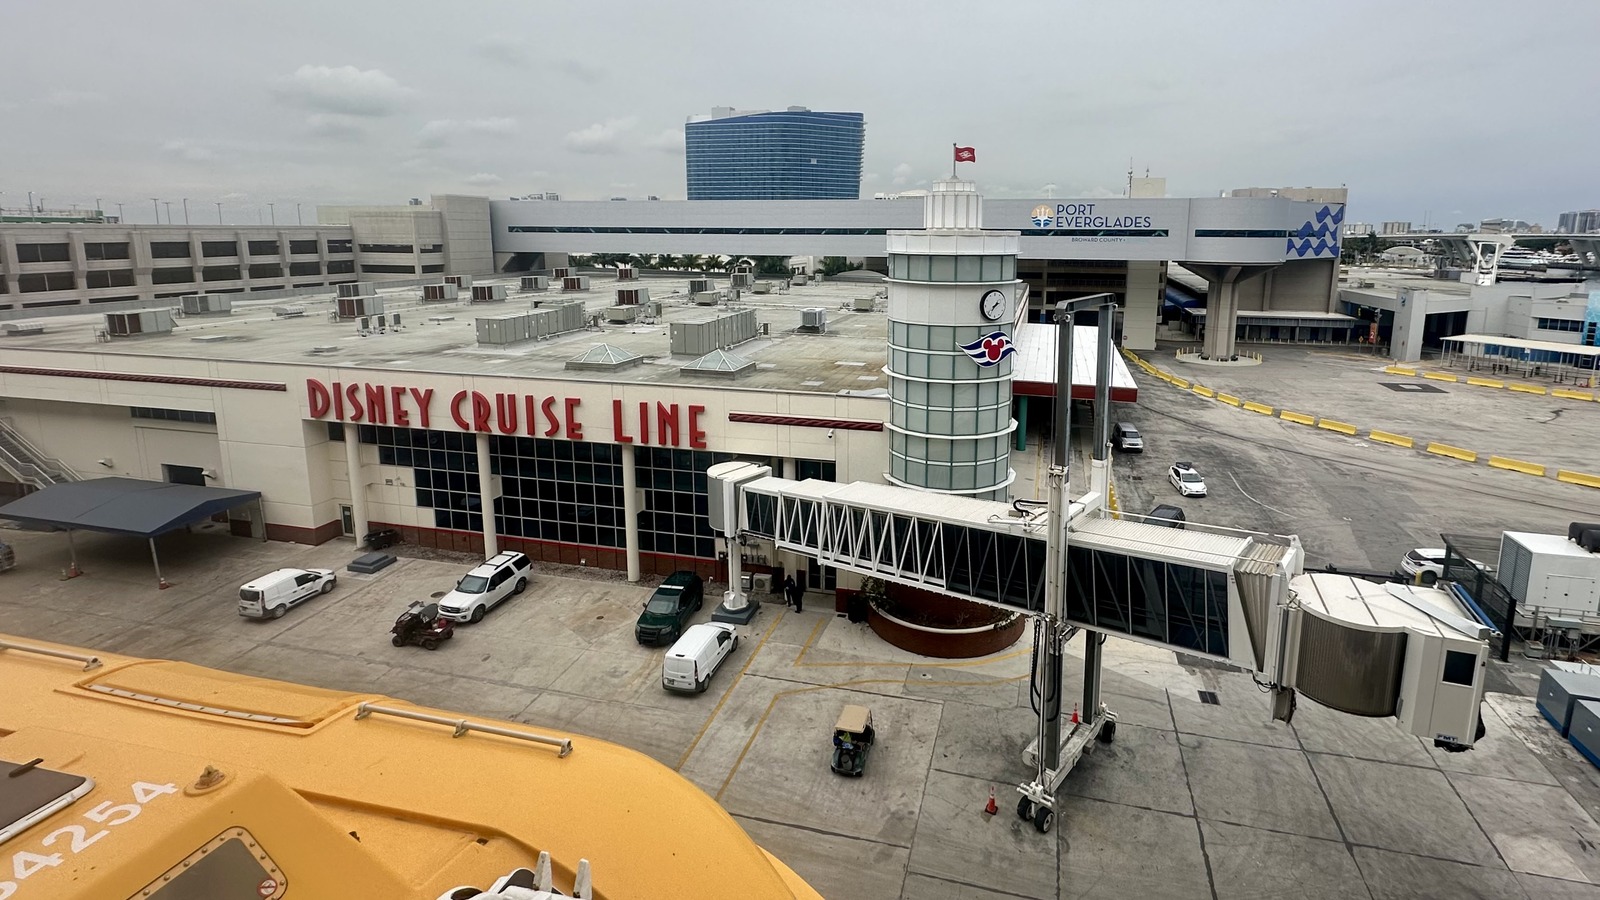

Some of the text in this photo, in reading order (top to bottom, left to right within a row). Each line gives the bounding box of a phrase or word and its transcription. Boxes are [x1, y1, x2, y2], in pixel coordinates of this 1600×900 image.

[1056, 204, 1095, 216] PORT
[1056, 216, 1151, 228] EVERGLADES
[306, 378, 707, 449] DISNEY CRUISE LINE
